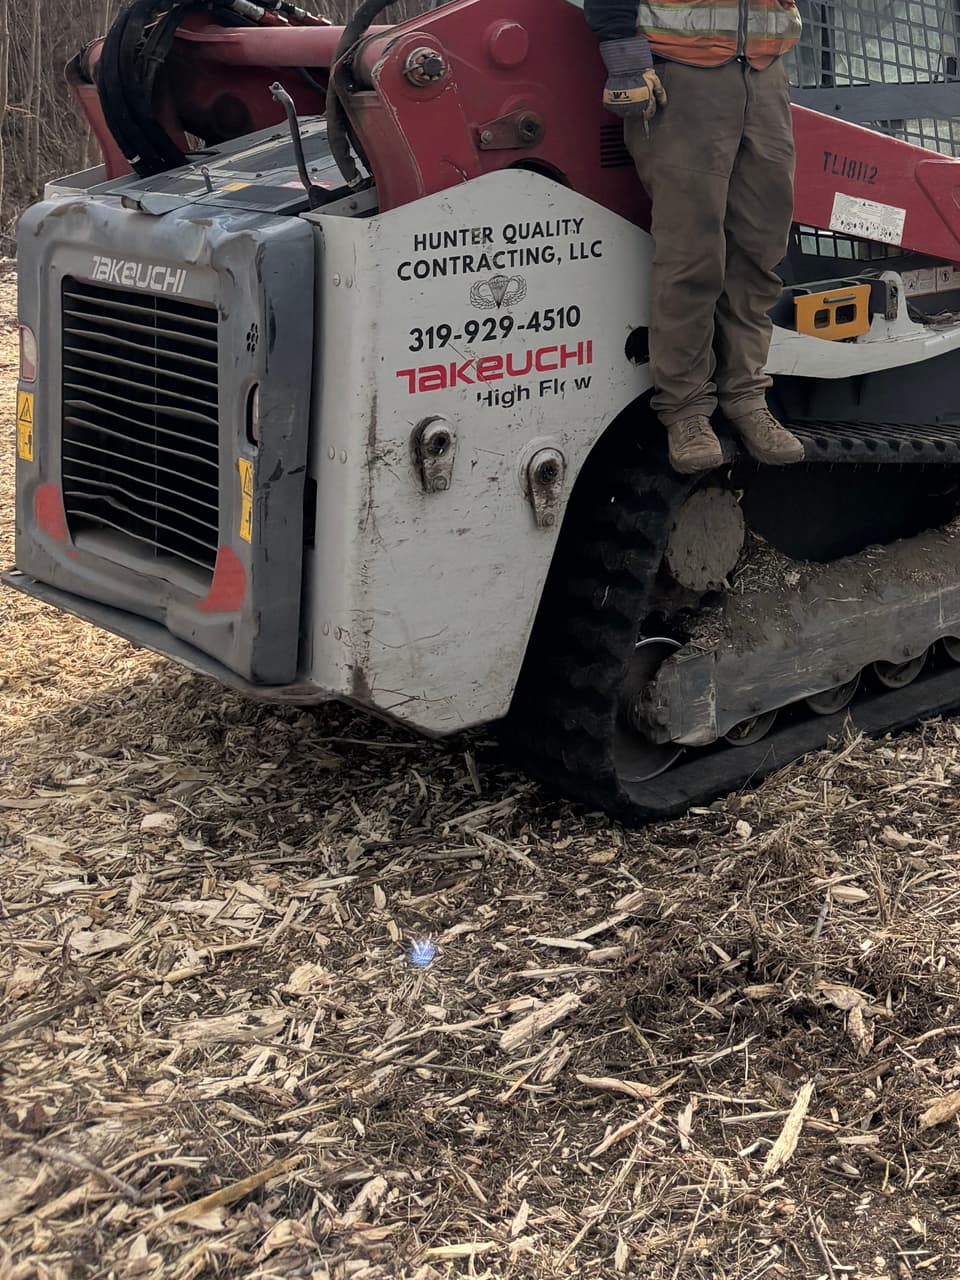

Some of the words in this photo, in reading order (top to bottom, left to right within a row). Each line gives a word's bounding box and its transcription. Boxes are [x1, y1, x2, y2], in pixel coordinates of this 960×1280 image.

[414, 226, 494, 252] HUNTER
[502, 218, 584, 245] QUALITY
[397, 245, 562, 281] CONTRACTING,
[569, 240, 603, 260] LLC
[408, 305, 581, 352] 319-929-4510
[476, 384, 530, 409] High
